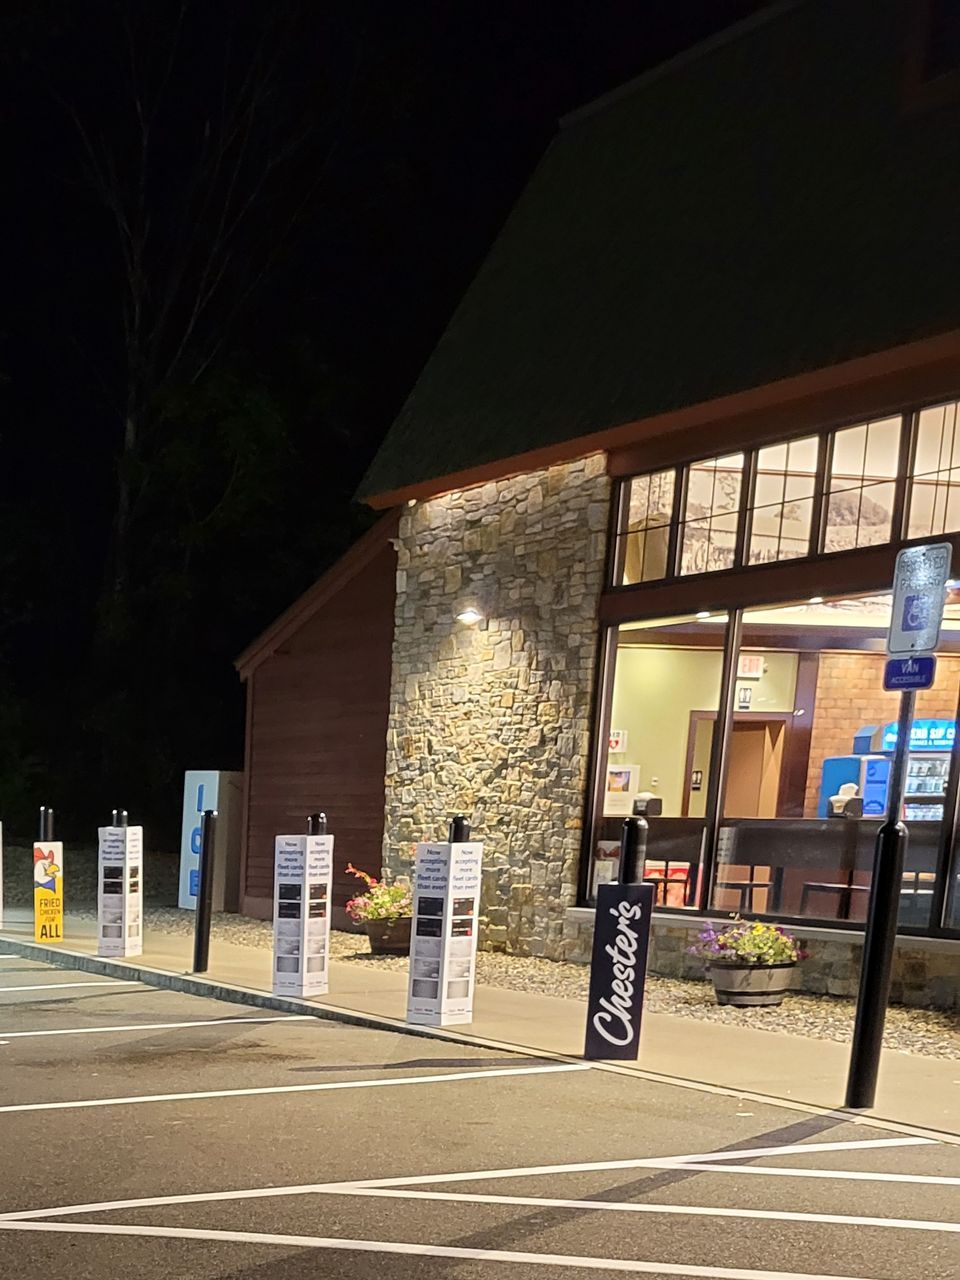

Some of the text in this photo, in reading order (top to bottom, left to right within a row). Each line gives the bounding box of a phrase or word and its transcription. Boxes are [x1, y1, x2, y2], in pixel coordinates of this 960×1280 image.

[901, 662, 919, 674] VAN
[40, 898, 60, 908] FRIED
[40, 924, 61, 938] ALL
[593, 900, 642, 1046] Chester's
